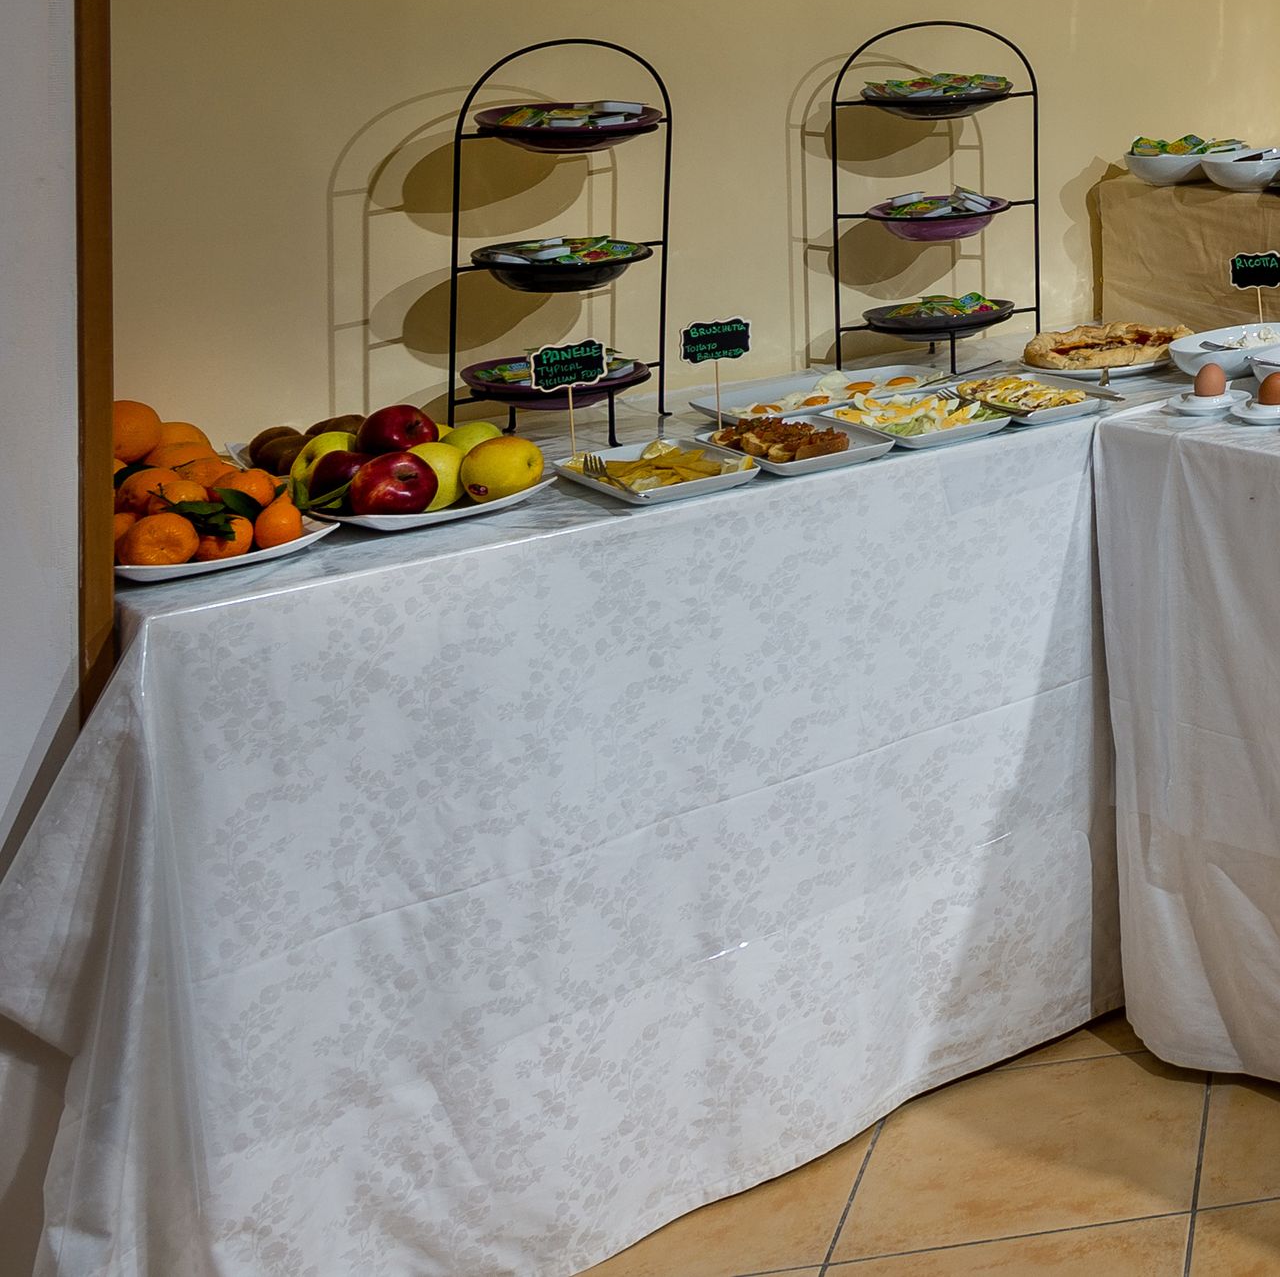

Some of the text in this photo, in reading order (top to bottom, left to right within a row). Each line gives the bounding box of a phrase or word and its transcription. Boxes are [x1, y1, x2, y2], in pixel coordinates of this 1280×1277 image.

[1235, 257, 1279, 269] RICOTTA
[685, 343, 717, 353] TOMATO
[541, 345, 600, 364] PANELLE
[536, 363, 583, 377] TYPICAL
[581, 368, 603, 380] FOOD
